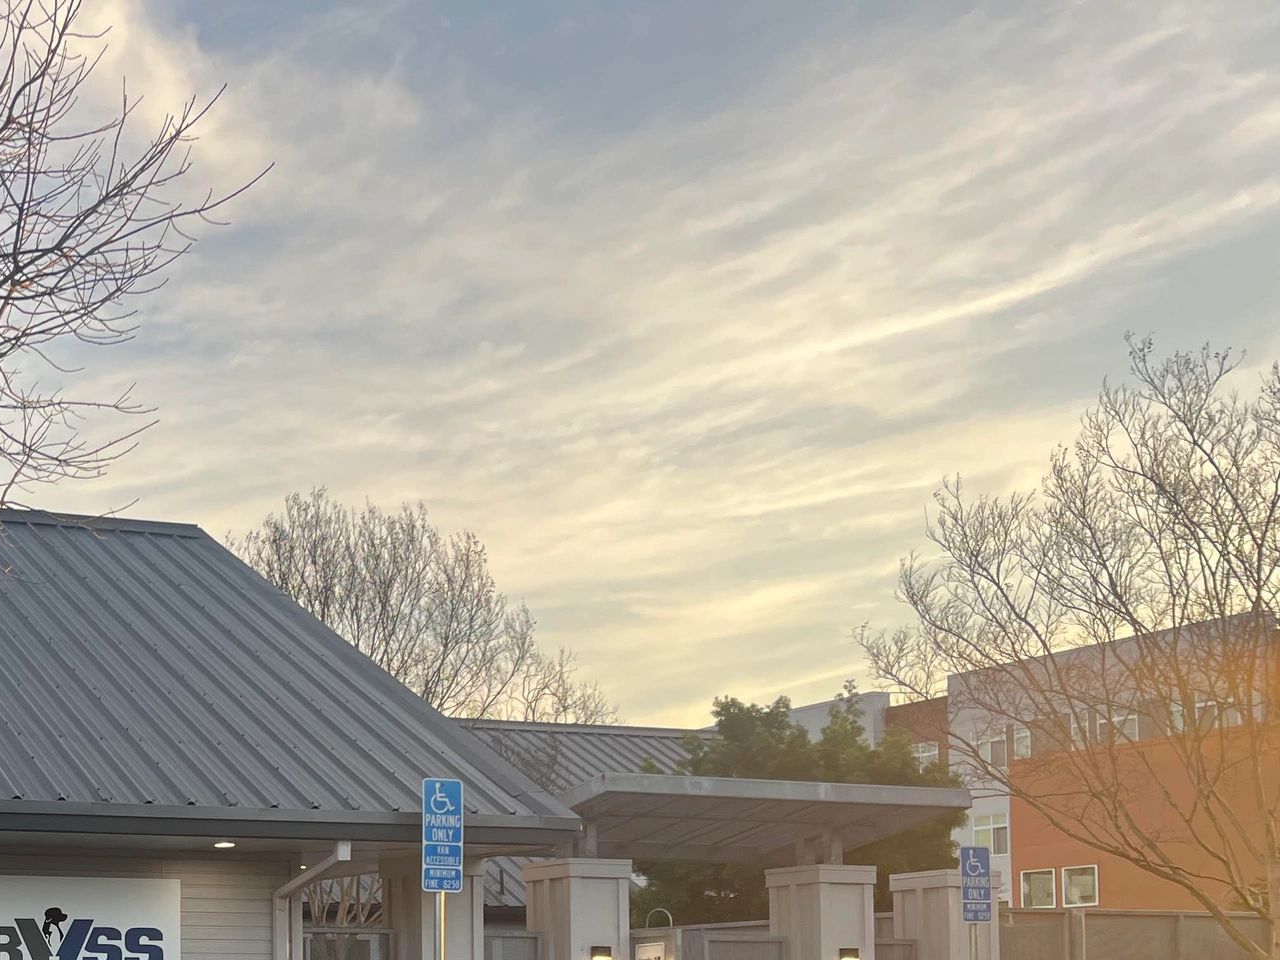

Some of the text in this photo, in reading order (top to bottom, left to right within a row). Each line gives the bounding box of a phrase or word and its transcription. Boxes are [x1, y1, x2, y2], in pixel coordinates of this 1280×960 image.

[425, 814, 460, 827] PARKING
[432, 828, 453, 841] ONLY
[437, 846, 449, 855] VAN
[425, 856, 459, 865] ACCESSIBLE
[429, 869, 455, 878] MINIMUM
[424, 879, 460, 889] FINE $250
[963, 877, 989, 887] PARKING
[968, 889, 984, 899] ONLY
